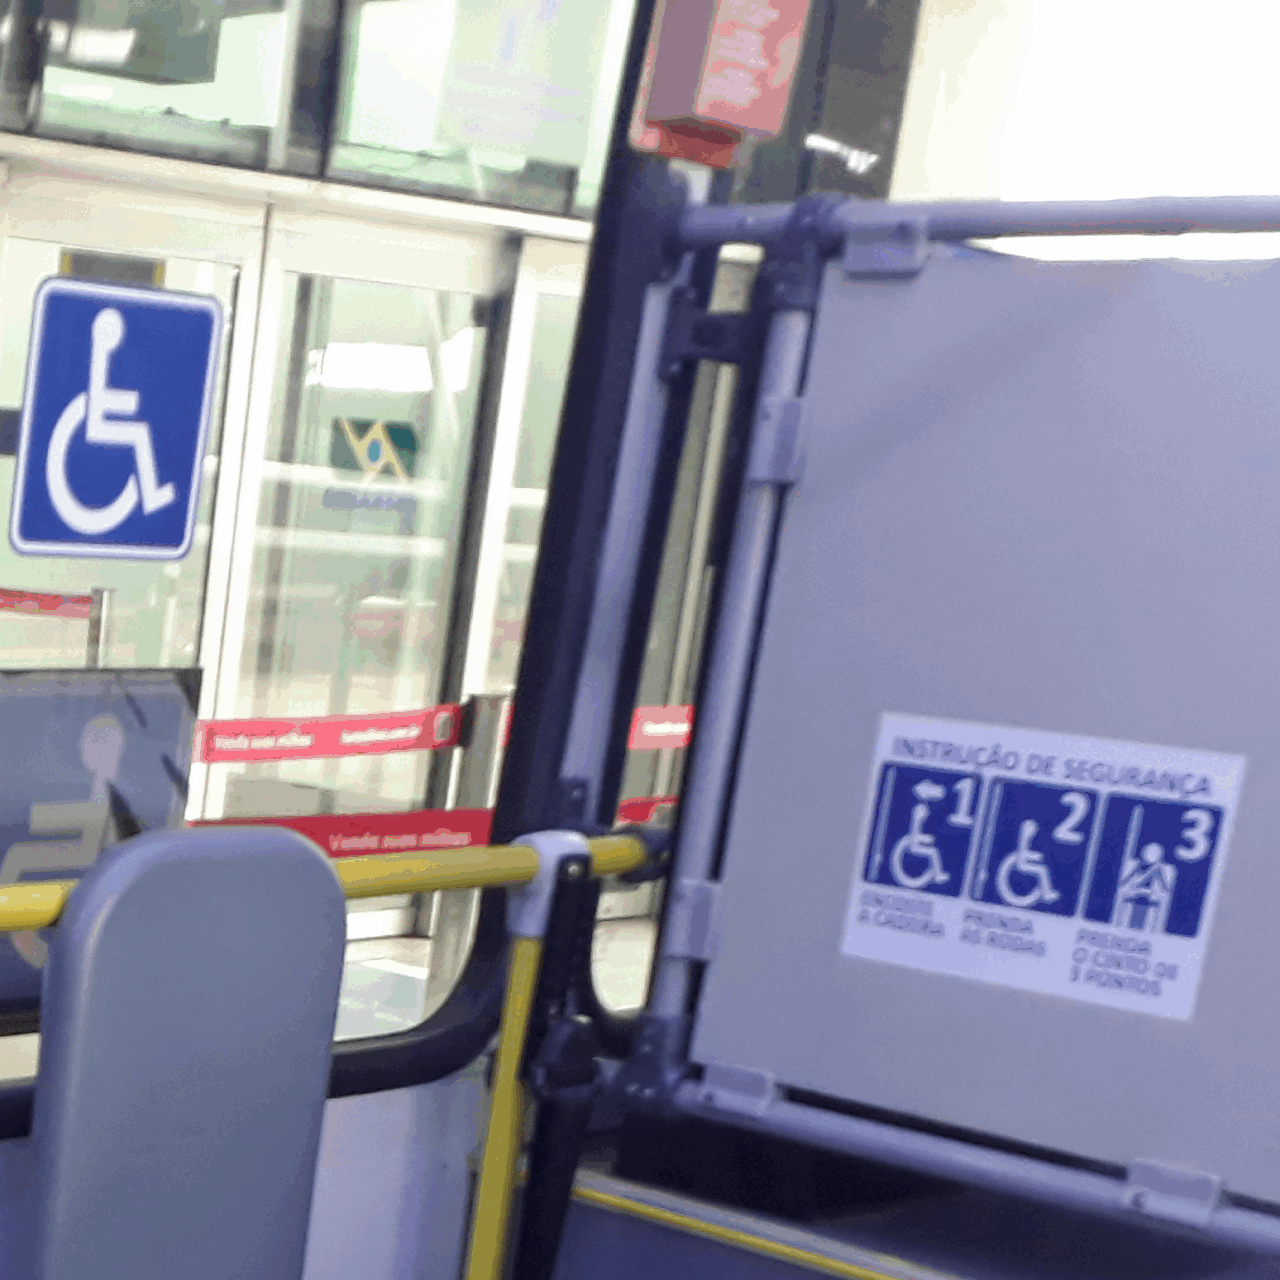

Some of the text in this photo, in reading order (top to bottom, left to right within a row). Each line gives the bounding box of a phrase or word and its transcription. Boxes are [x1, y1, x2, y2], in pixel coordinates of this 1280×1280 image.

[892, 736, 1213, 797] INSTRUÇÃO DE SEGURANÇA
[946, 777, 975, 828] 1
[1051, 791, 1091, 844] 2
[1174, 808, 1214, 861] 3
